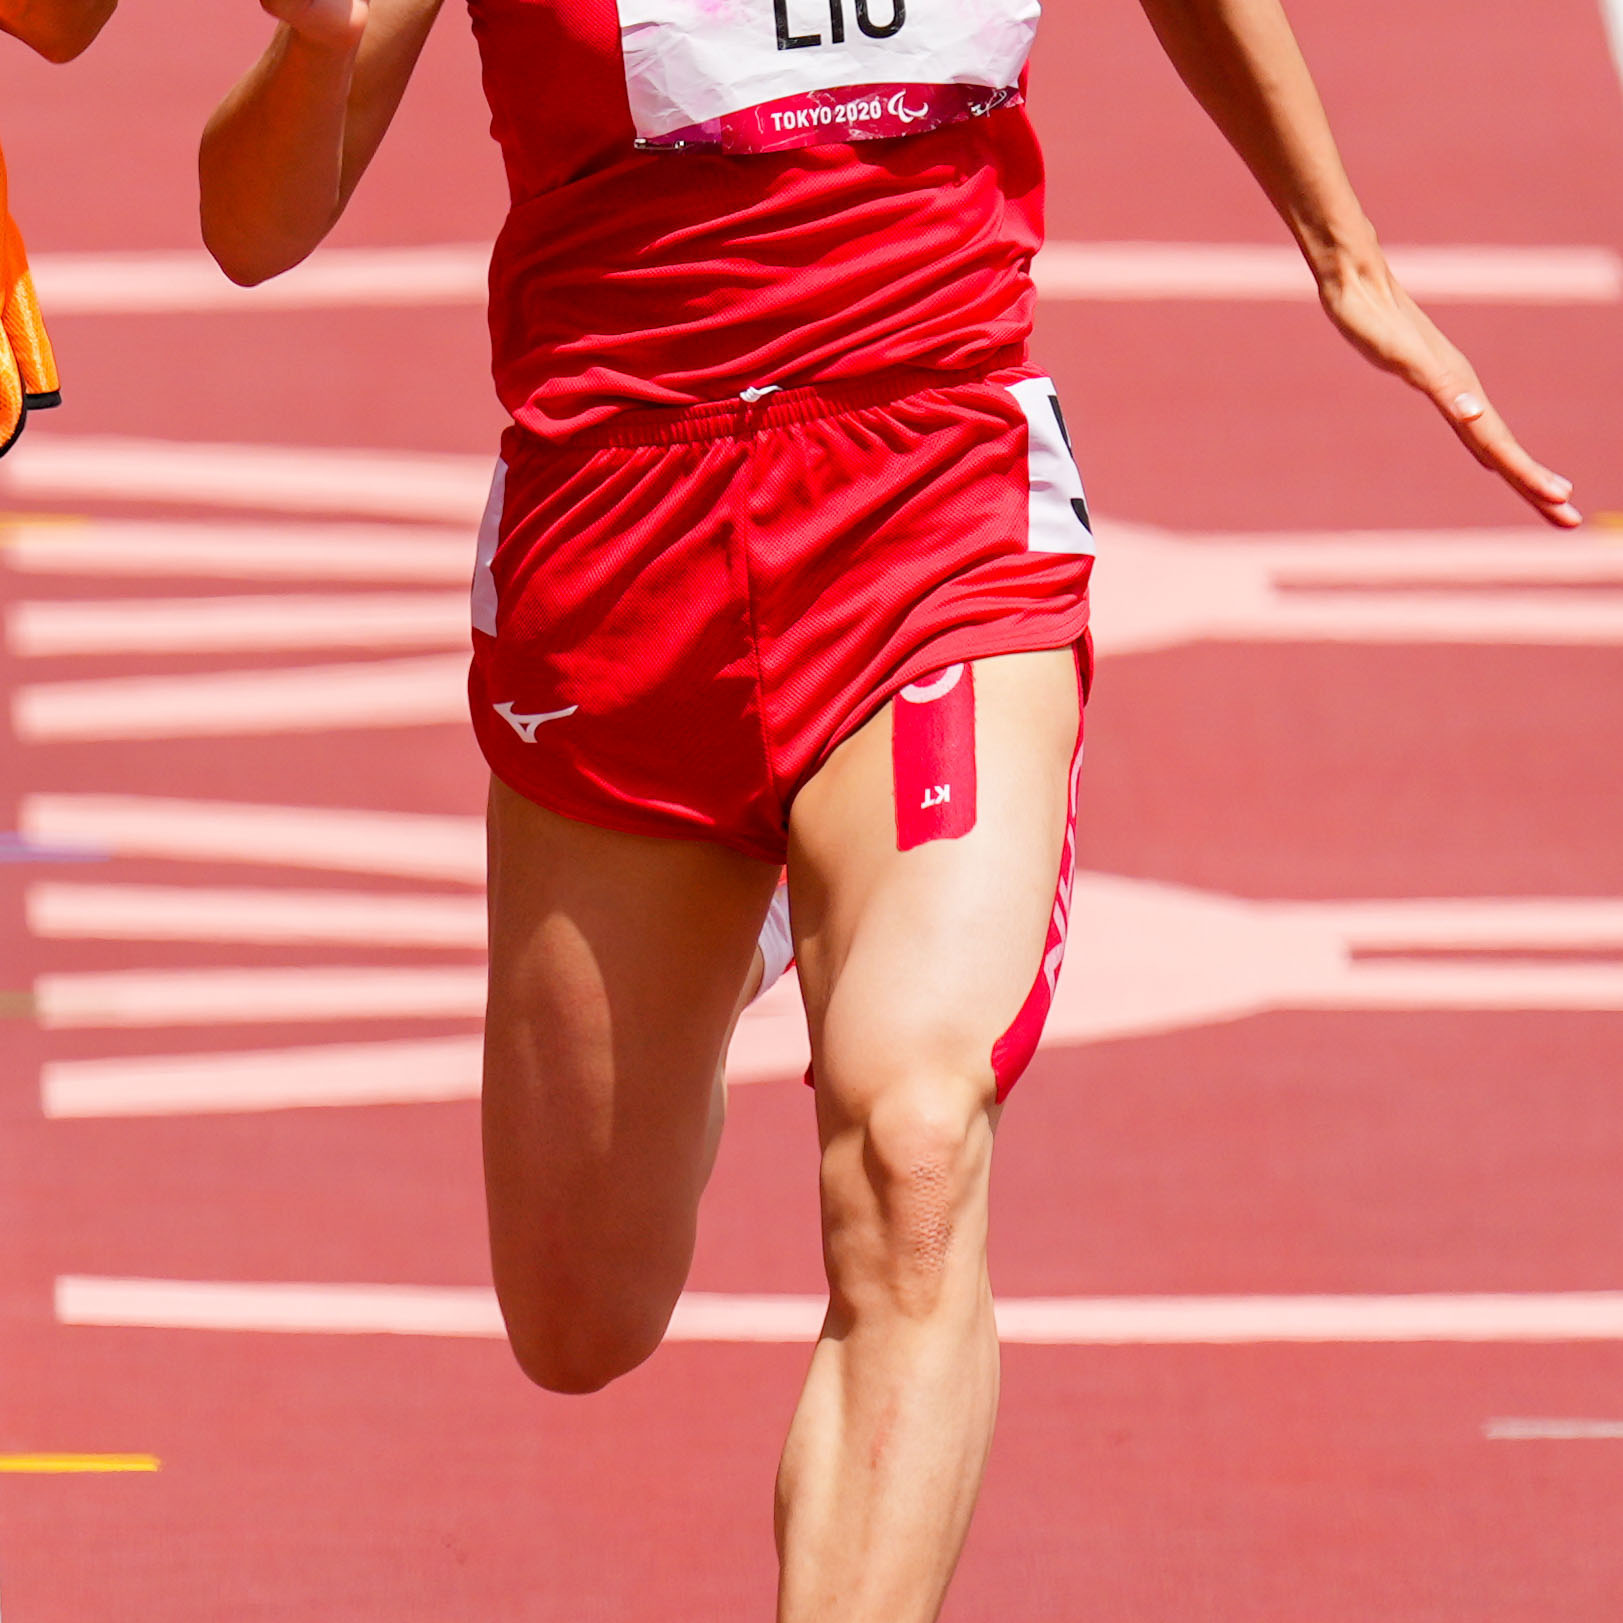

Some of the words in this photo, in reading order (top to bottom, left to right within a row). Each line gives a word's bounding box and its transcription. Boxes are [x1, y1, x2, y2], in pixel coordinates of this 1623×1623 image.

[770, 105, 833, 132] TOKYO
[834, 99, 883, 124] 2020
[920, 783, 952, 810] KT
